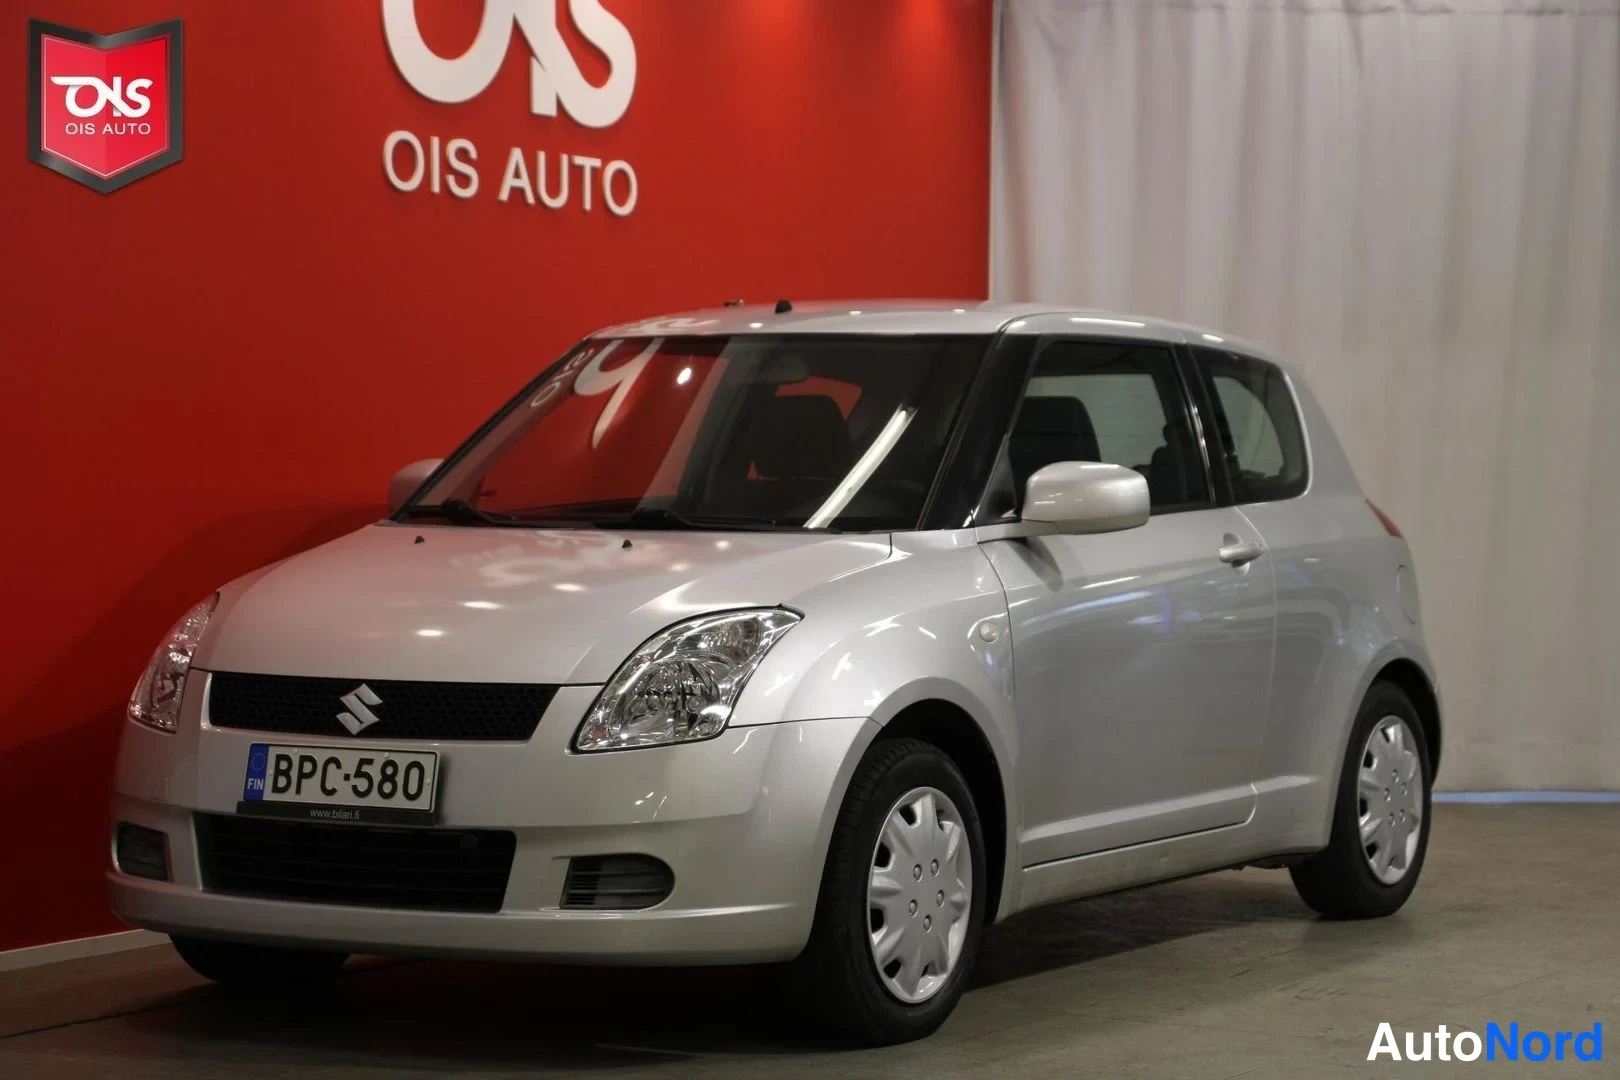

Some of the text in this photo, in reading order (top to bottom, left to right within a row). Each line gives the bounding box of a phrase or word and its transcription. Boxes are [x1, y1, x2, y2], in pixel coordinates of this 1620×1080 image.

[383, 130, 638, 216] OIS AUTO
[247, 753, 425, 801] FIN BPC-580
[310, 807, 360, 820] www.bilari.fi
